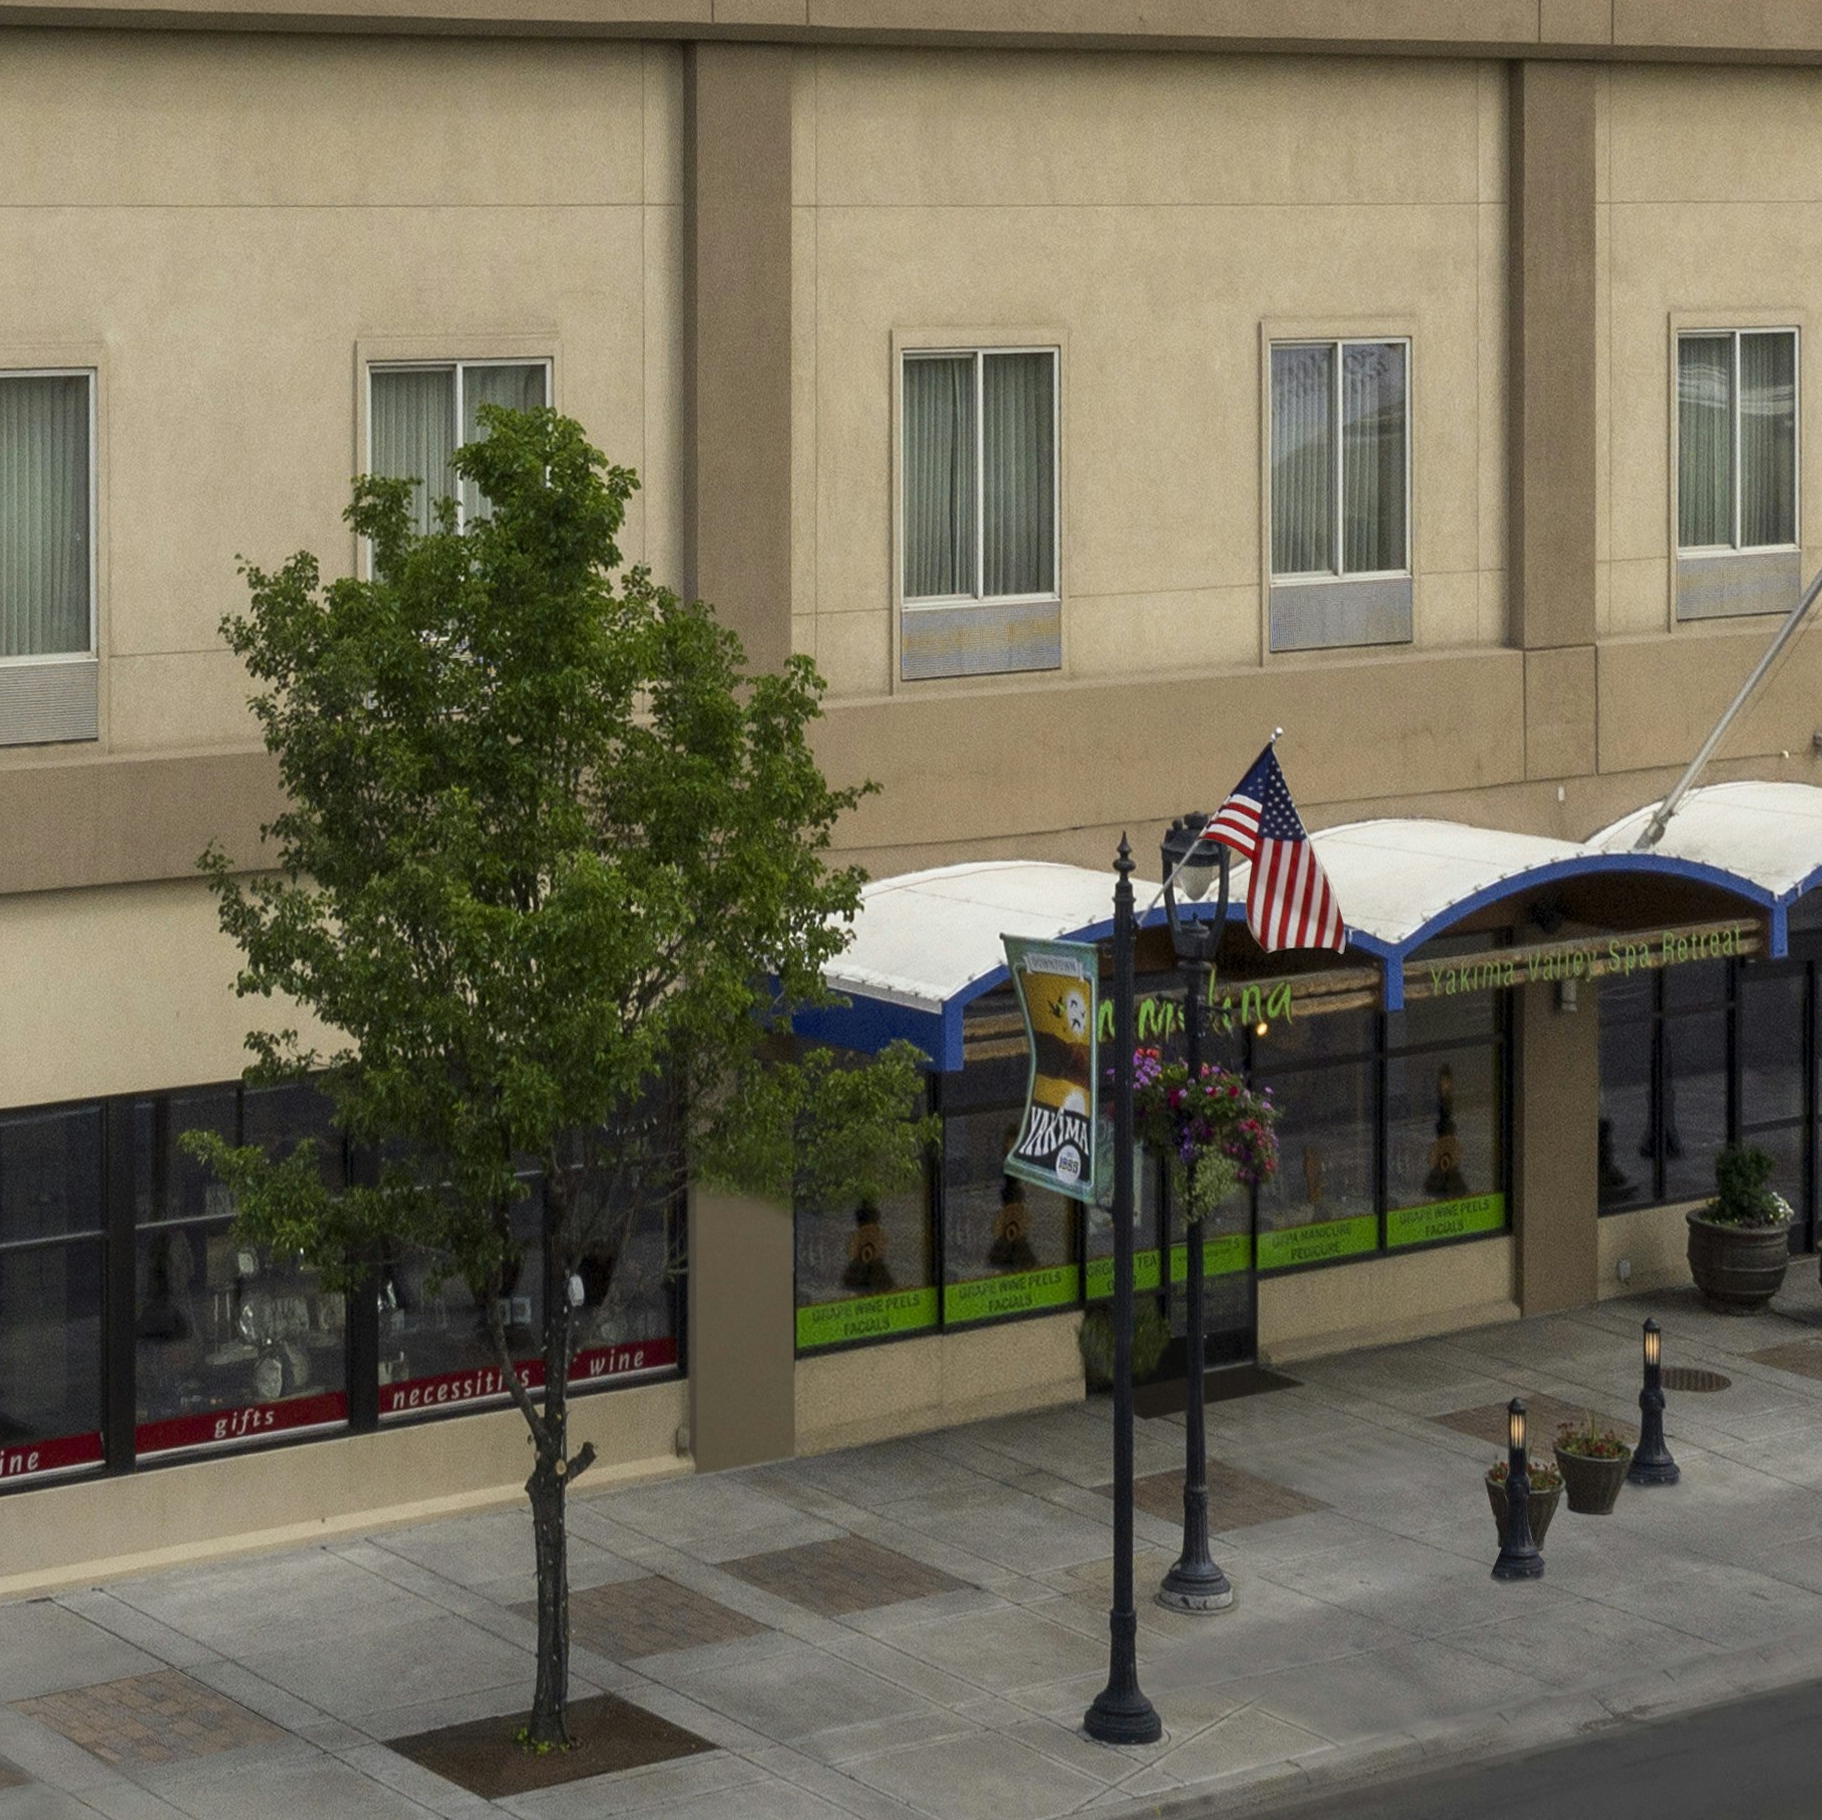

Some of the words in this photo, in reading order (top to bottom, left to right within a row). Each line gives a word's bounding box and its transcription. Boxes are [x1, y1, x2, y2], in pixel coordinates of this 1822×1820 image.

[1431, 961, 1514, 996] Yakima
[1527, 948, 1597, 983] Valley
[1608, 939, 1650, 976] Spa
[1662, 926, 1743, 963] Retreat
[1019, 1105, 1091, 1157] YAKIMA
[589, 1347, 646, 1377] wine
[392, 1368, 530, 1410] necessitis
[214, 1409, 276, 1440] gifts
